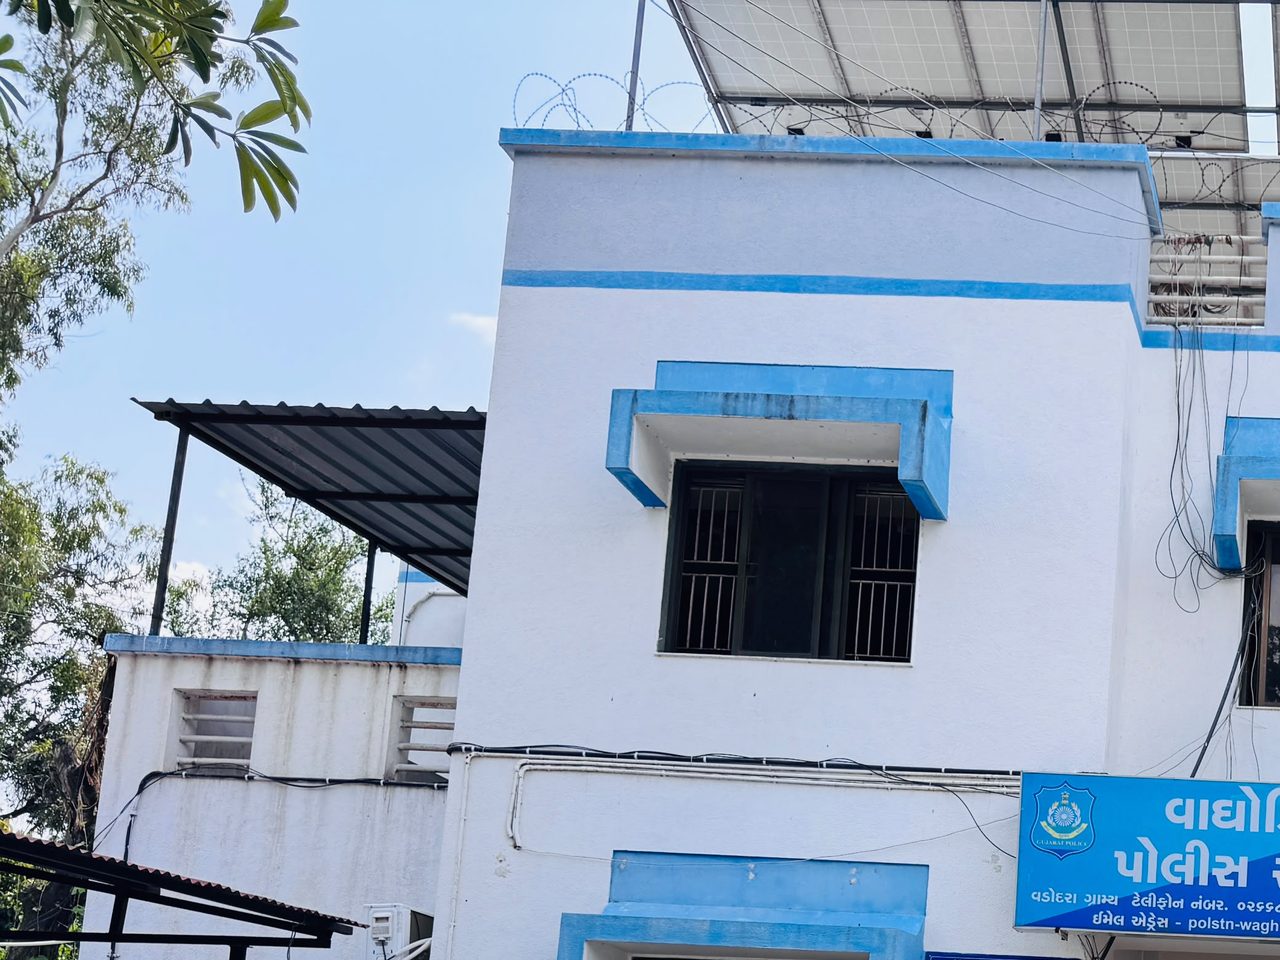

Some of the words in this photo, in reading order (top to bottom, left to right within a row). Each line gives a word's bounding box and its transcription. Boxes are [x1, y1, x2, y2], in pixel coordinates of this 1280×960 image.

[1114, 837, 1248, 887] પોલીસ
[1031, 888, 1077, 903] વડોદરા
[1084, 894, 1118, 907] ગ્રામ્ય
[1131, 891, 1184, 910] ટેલીફોન
[1190, 895, 1228, 911] નંબર.
[1092, 911, 1124, 926] ઈમેલ
[1131, 911, 1169, 931] એડ્રેસ
